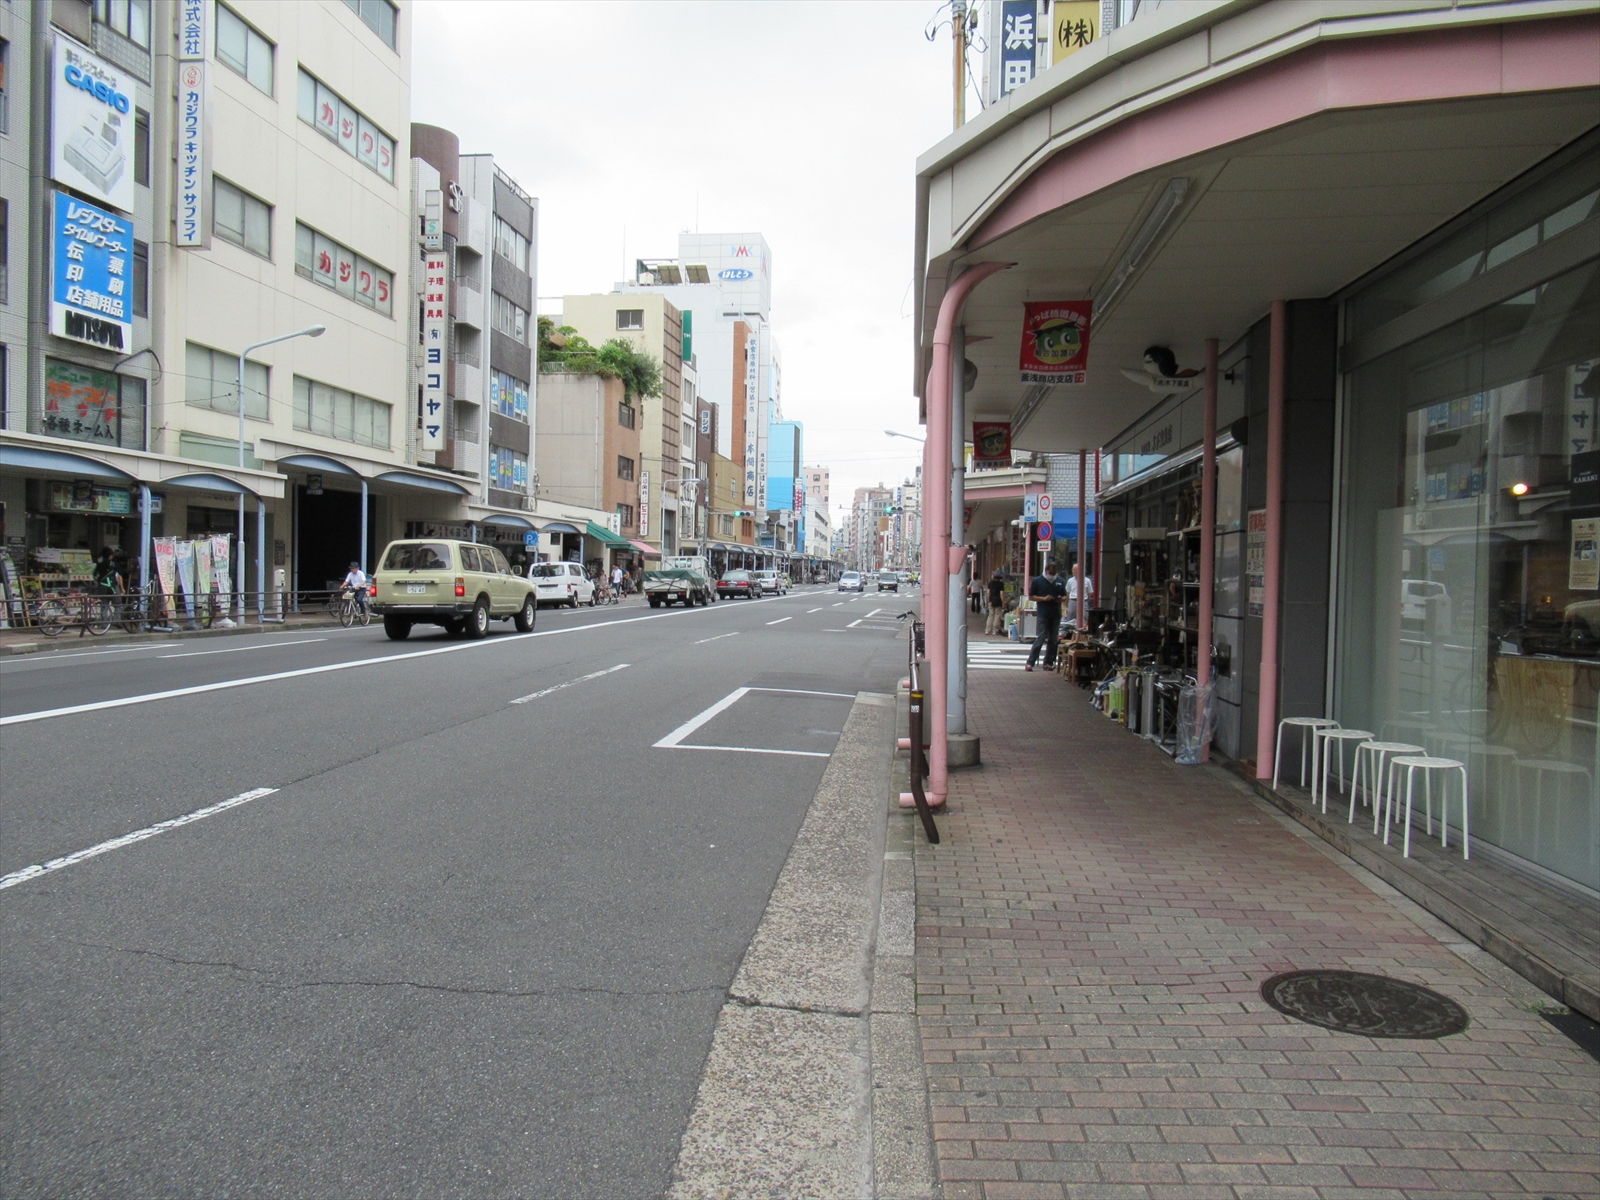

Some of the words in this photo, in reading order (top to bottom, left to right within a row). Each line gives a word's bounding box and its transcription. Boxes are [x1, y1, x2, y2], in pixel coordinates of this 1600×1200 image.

[1005, 13, 1034, 92] 浜田
[64, 64, 129, 114] CASIO
[322, 102, 390, 167] カジワラ
[67, 202, 125, 234] レジスター
[320, 250, 388, 302] カジワラ
[722, 270, 749, 279] はしとう
[66, 285, 124, 318] 店舗用品
[426, 348, 441, 438] ヨコヤマ
[1076, 373, 1085, 383] 72
